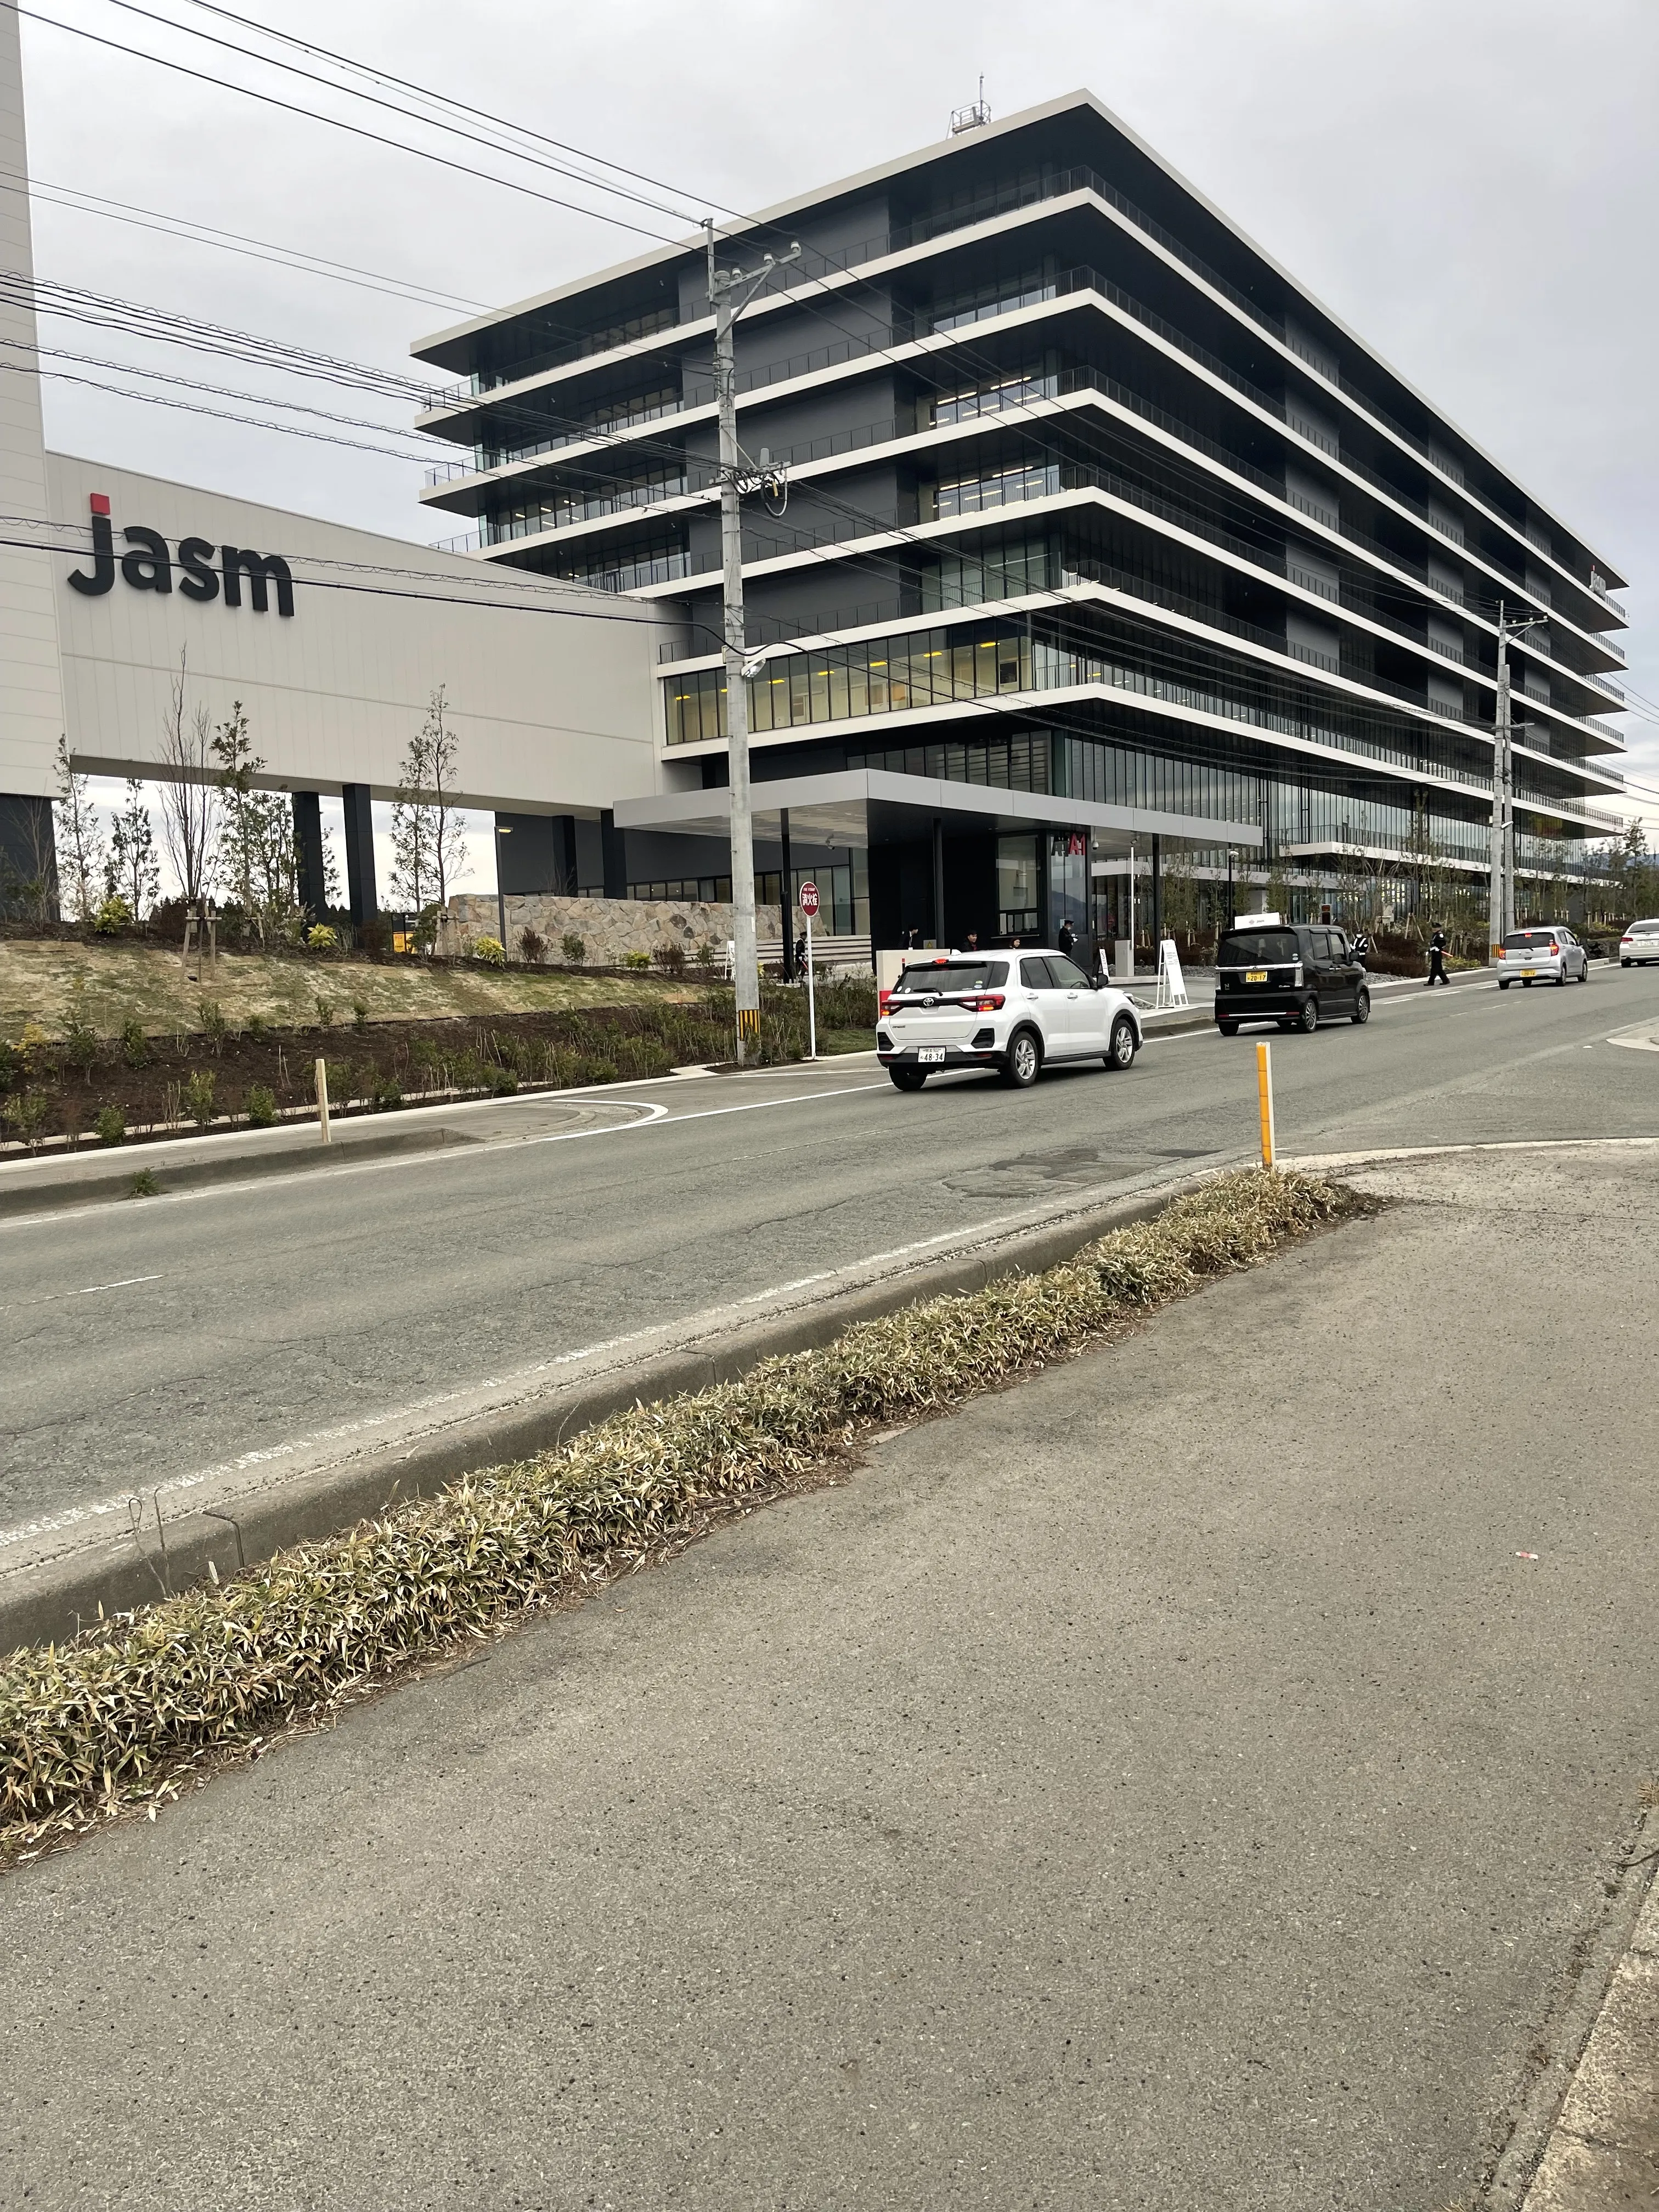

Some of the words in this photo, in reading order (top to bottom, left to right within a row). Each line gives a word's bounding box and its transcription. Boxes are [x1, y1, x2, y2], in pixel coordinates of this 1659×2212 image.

[67, 493, 294, 617] jasm
[802, 893, 817, 906] 消火栓
